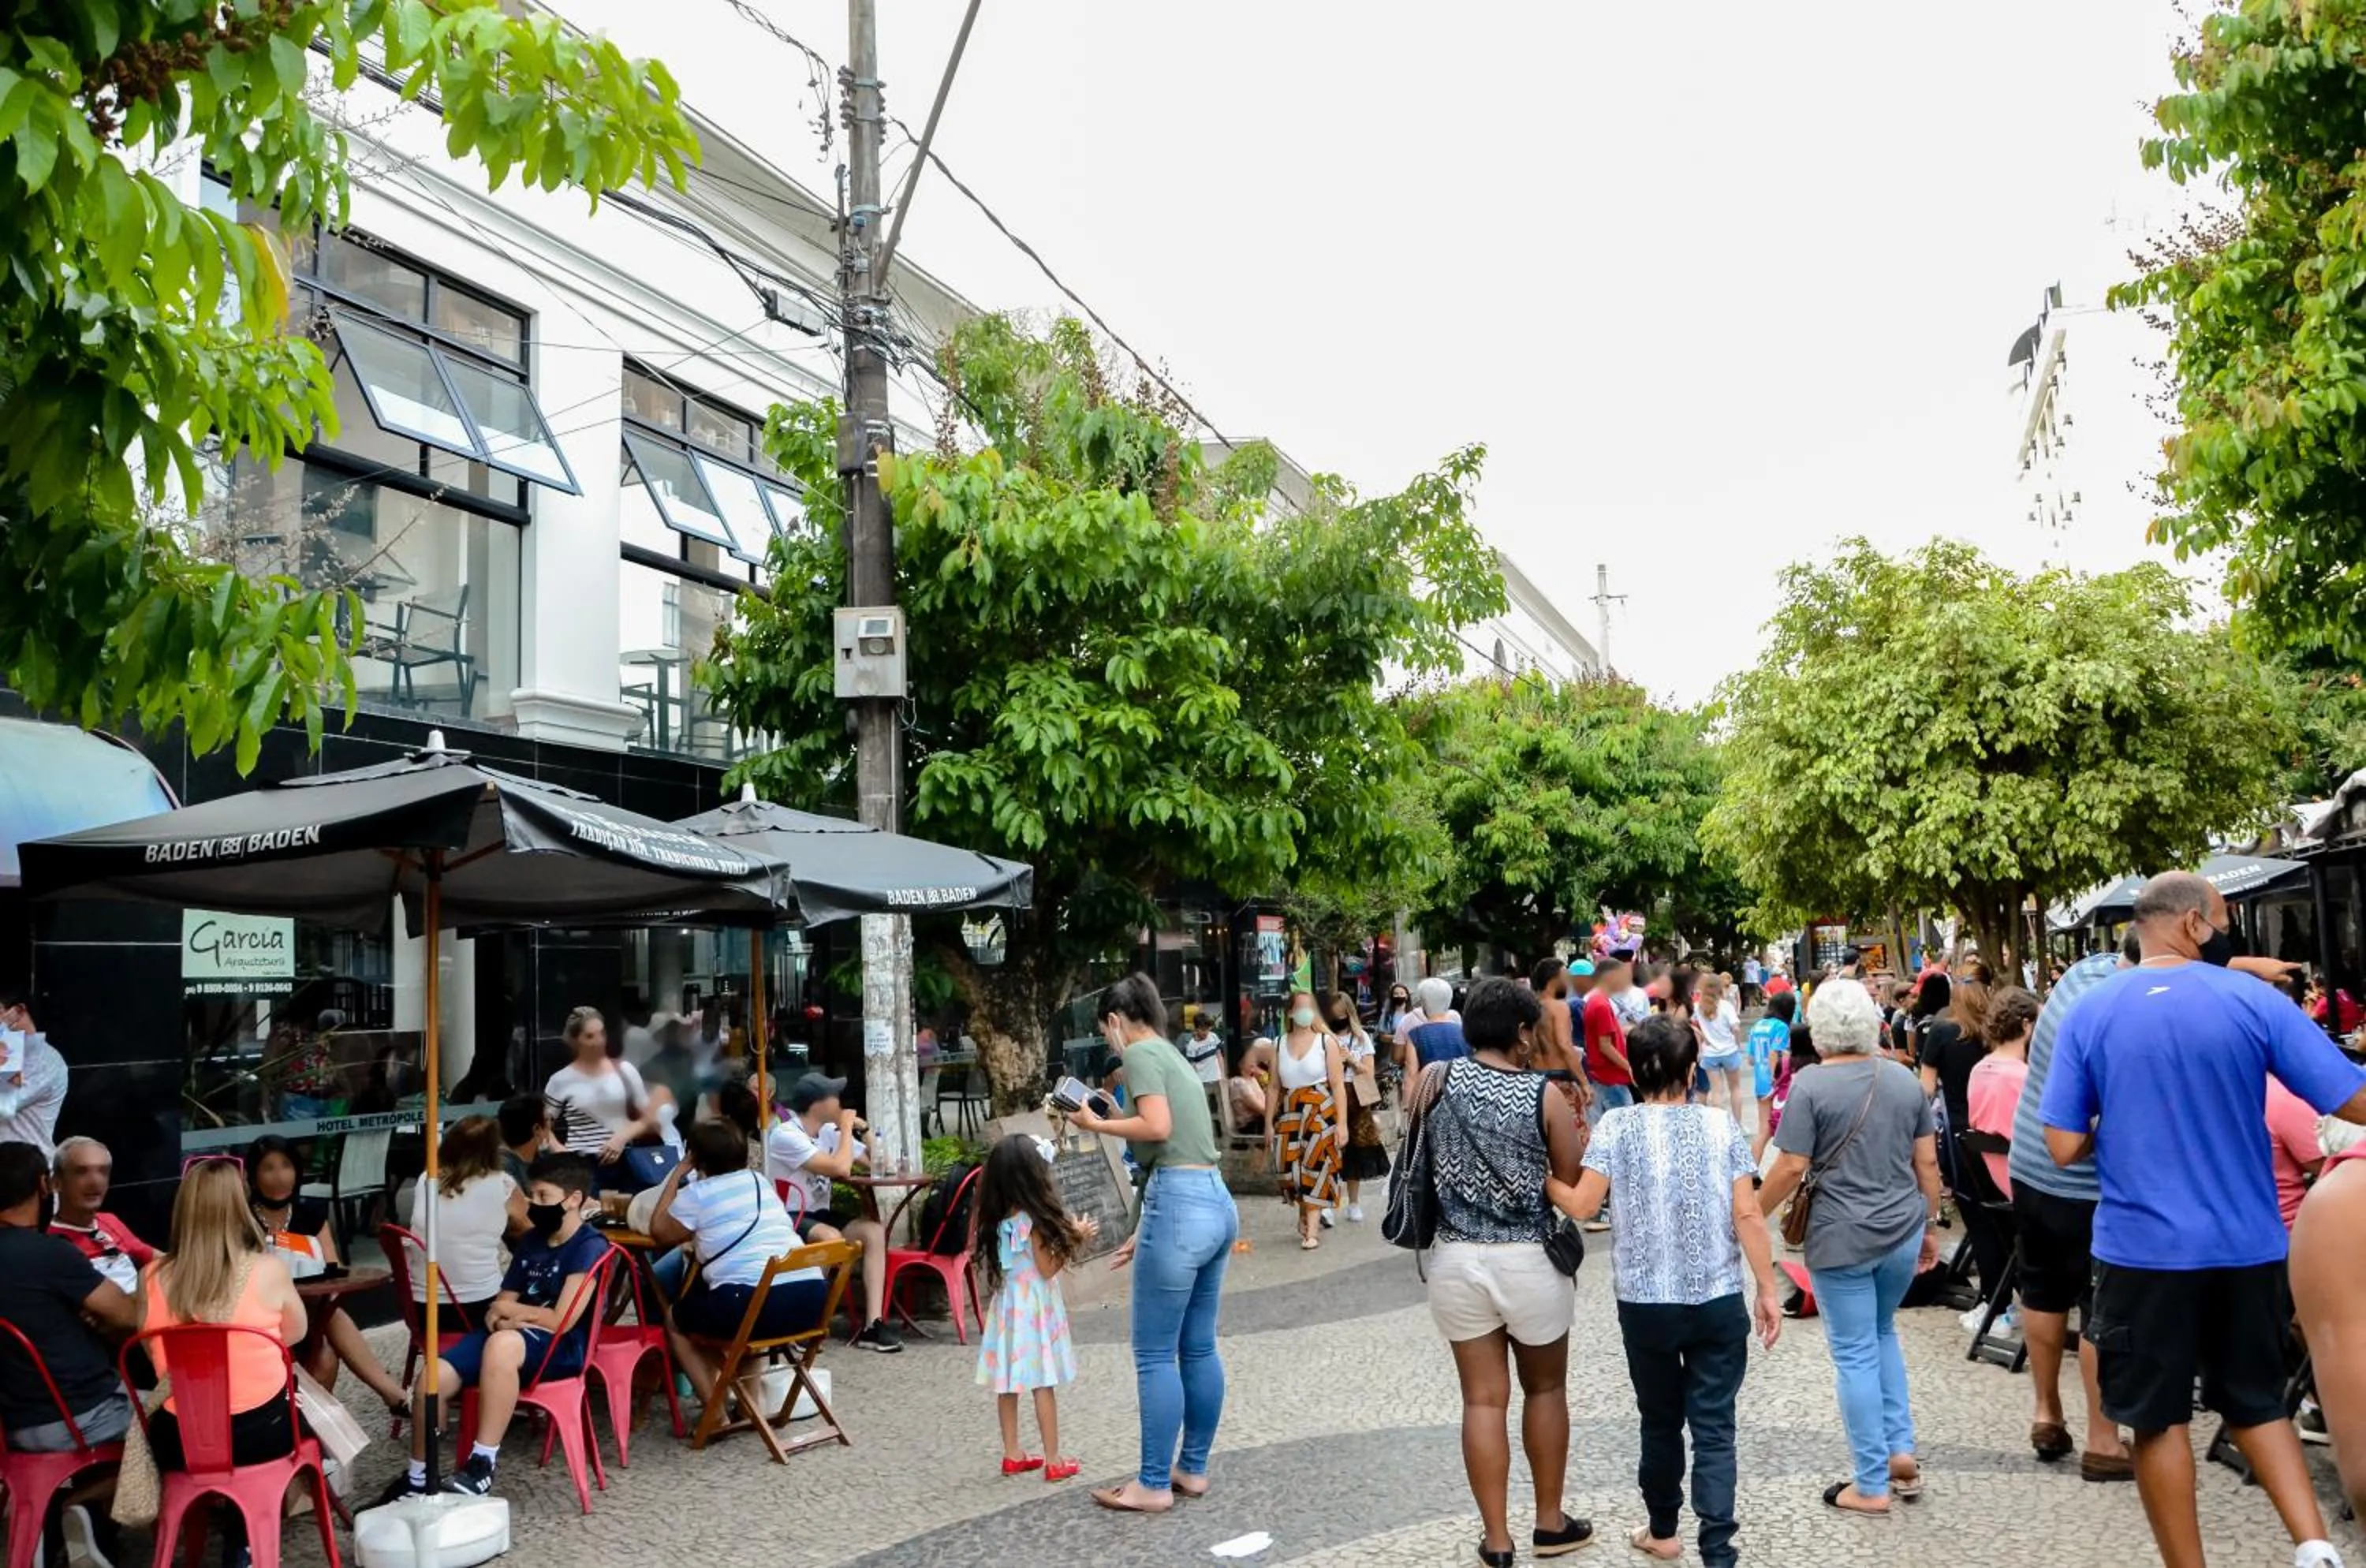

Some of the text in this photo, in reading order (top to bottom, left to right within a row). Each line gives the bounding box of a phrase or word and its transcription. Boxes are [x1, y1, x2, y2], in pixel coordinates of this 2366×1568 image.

[145, 839, 215, 863] BADEN
[247, 825, 322, 853] BADEN
[886, 889, 926, 905] BADEN
[940, 887, 977, 902] BADEN
[317, 1111, 424, 1133] HOTEL METRÓPOLE
